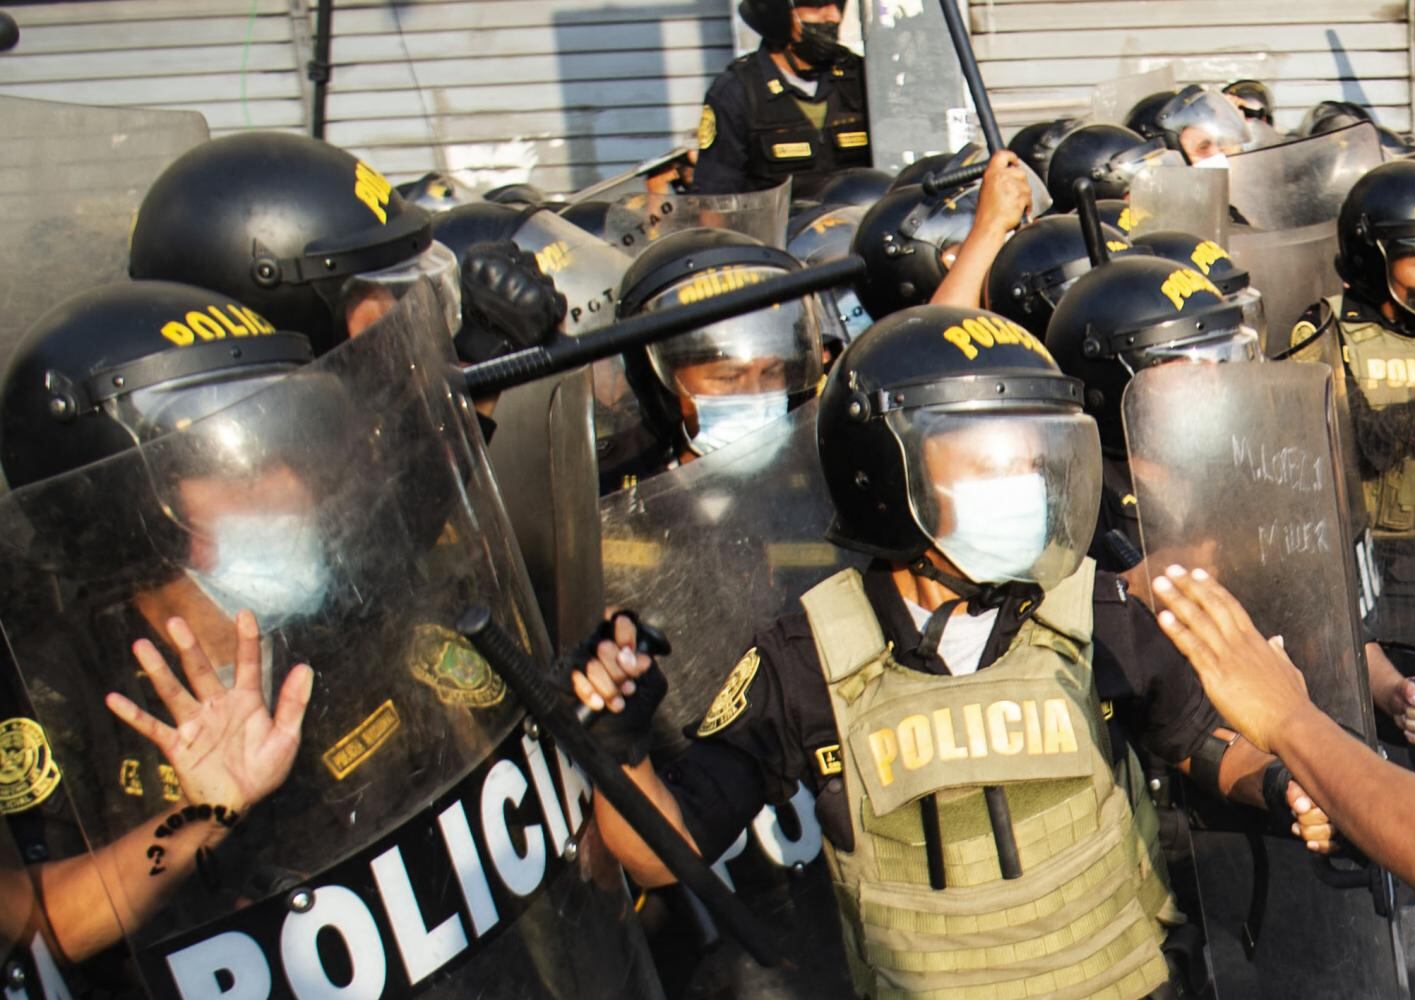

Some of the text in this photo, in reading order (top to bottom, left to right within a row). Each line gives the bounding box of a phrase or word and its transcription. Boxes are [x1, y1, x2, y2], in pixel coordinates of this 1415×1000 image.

[611, 201, 673, 248] OTAO
[570, 287, 616, 323] POT
[869, 698, 1079, 787] POLICIA
